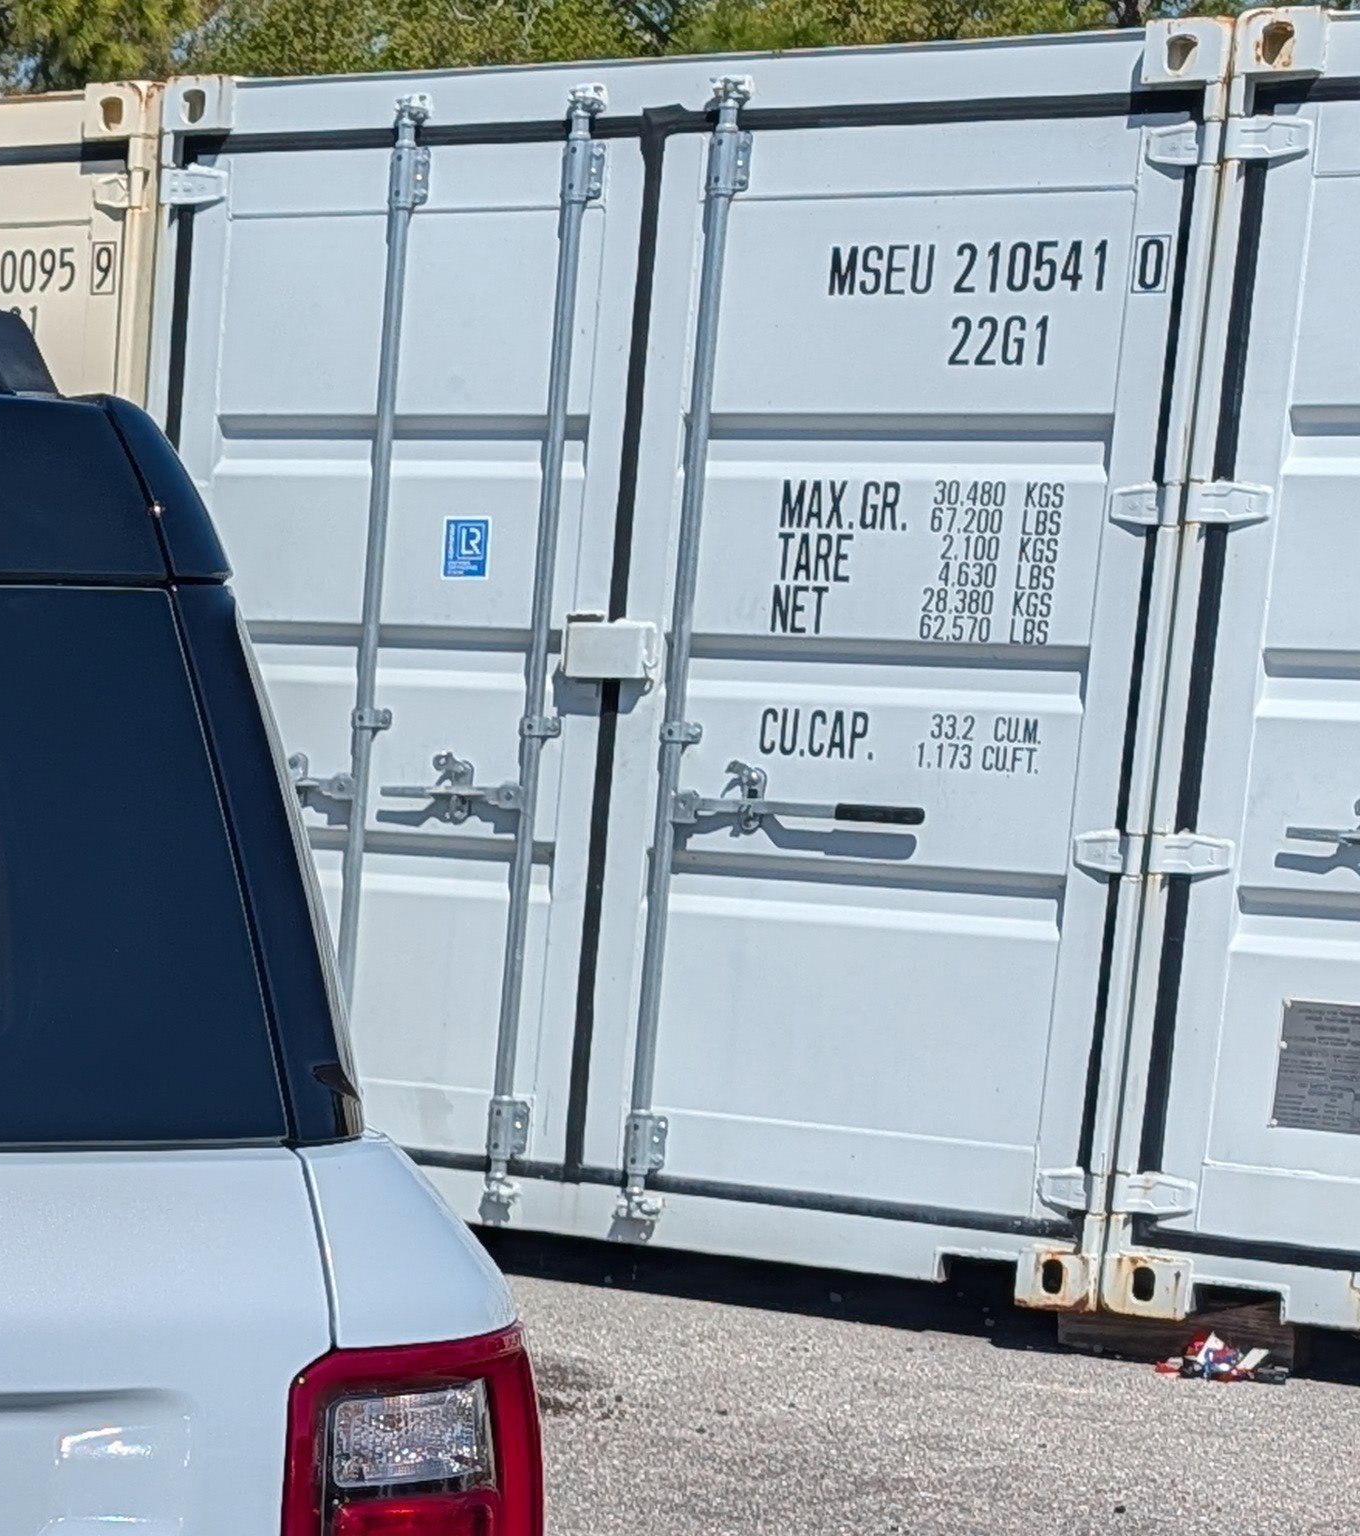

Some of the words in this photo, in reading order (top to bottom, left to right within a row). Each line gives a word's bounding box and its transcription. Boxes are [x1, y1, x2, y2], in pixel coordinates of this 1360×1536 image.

[95, 246, 112, 290] 9
[828, 244, 936, 296] MSEU
[953, 239, 1108, 293] 210541
[1138, 239, 1165, 290] 0
[948, 315, 1049, 366] 22G1
[780, 479, 907, 531] MAX.GR.
[1024, 482, 1065, 509] KGS
[1021, 510, 1062, 536] LBS
[778, 532, 854, 583] TARE
[1017, 537, 1059, 564] KGS
[1015, 564, 1055, 591] LBS
[770, 584, 829, 634] NET
[1012, 591, 1053, 618] KGS
[1009, 618, 1050, 645] LBS
[759, 708, 873, 760] CU.CAP.
[930, 713, 976, 741] 33.2
